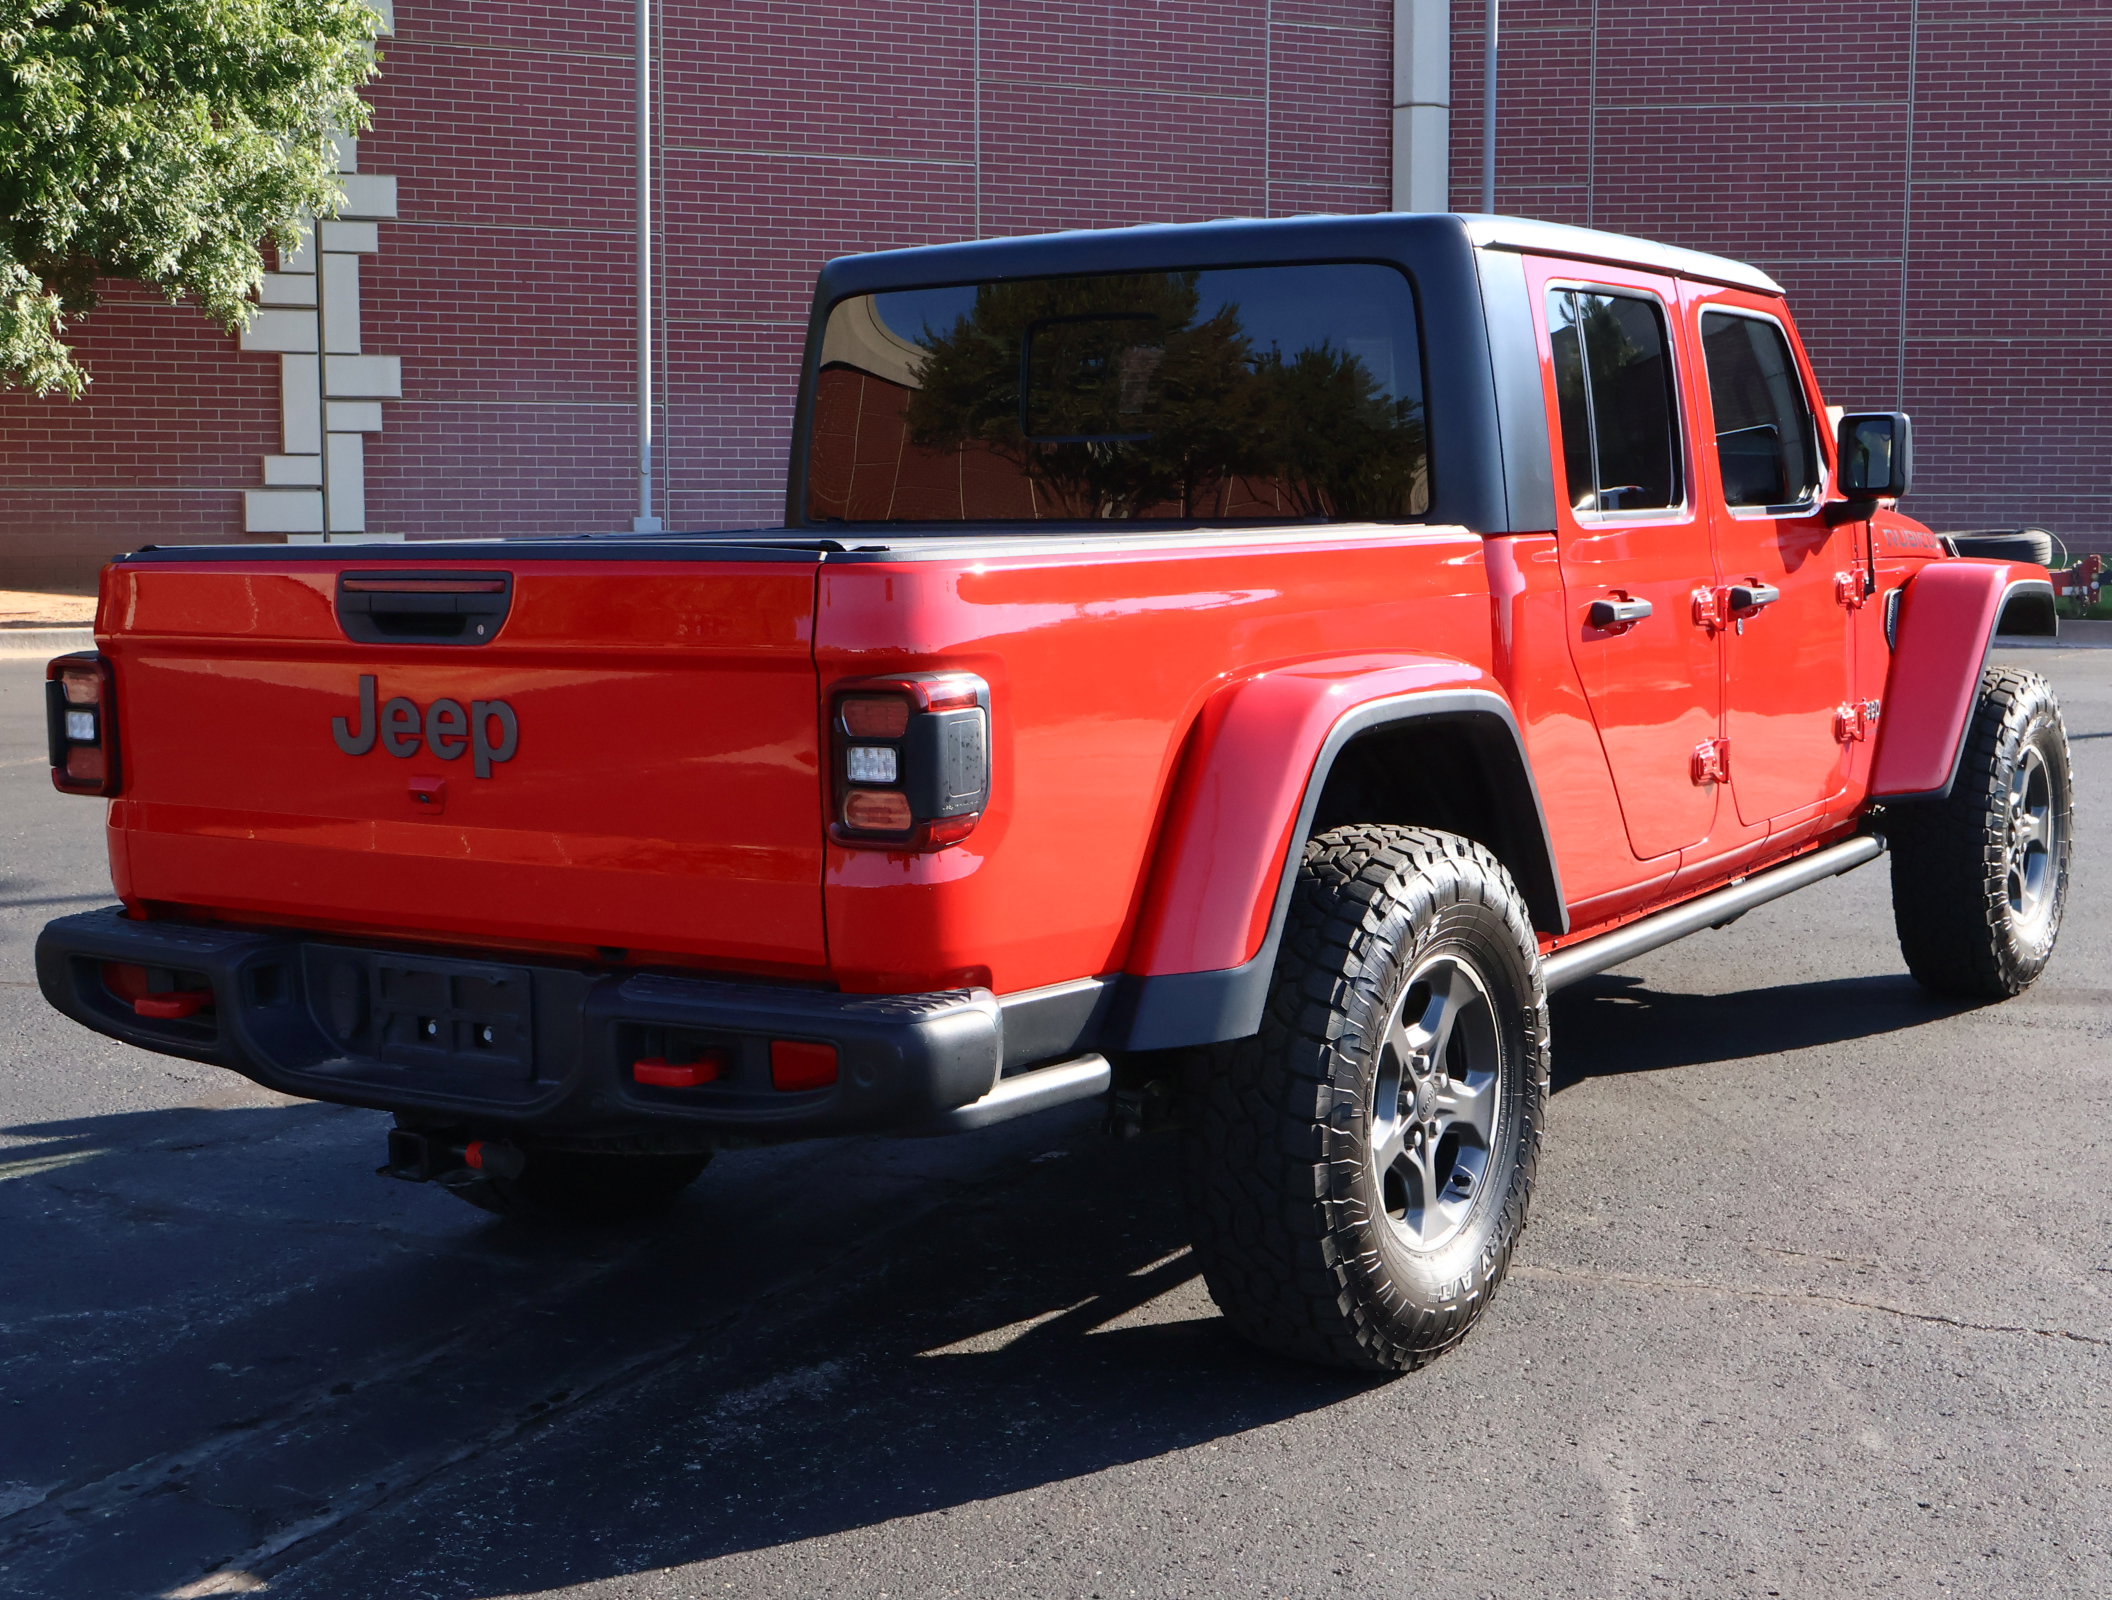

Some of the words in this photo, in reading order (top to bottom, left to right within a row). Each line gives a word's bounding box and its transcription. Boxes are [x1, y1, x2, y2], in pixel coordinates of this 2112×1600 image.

[1882, 528, 1937, 549] RUBICO
[331, 674, 518, 779] Jeep
[1523, 1005, 1536, 1109] OPEN
[1480, 1115, 1533, 1275] COUNTRY
